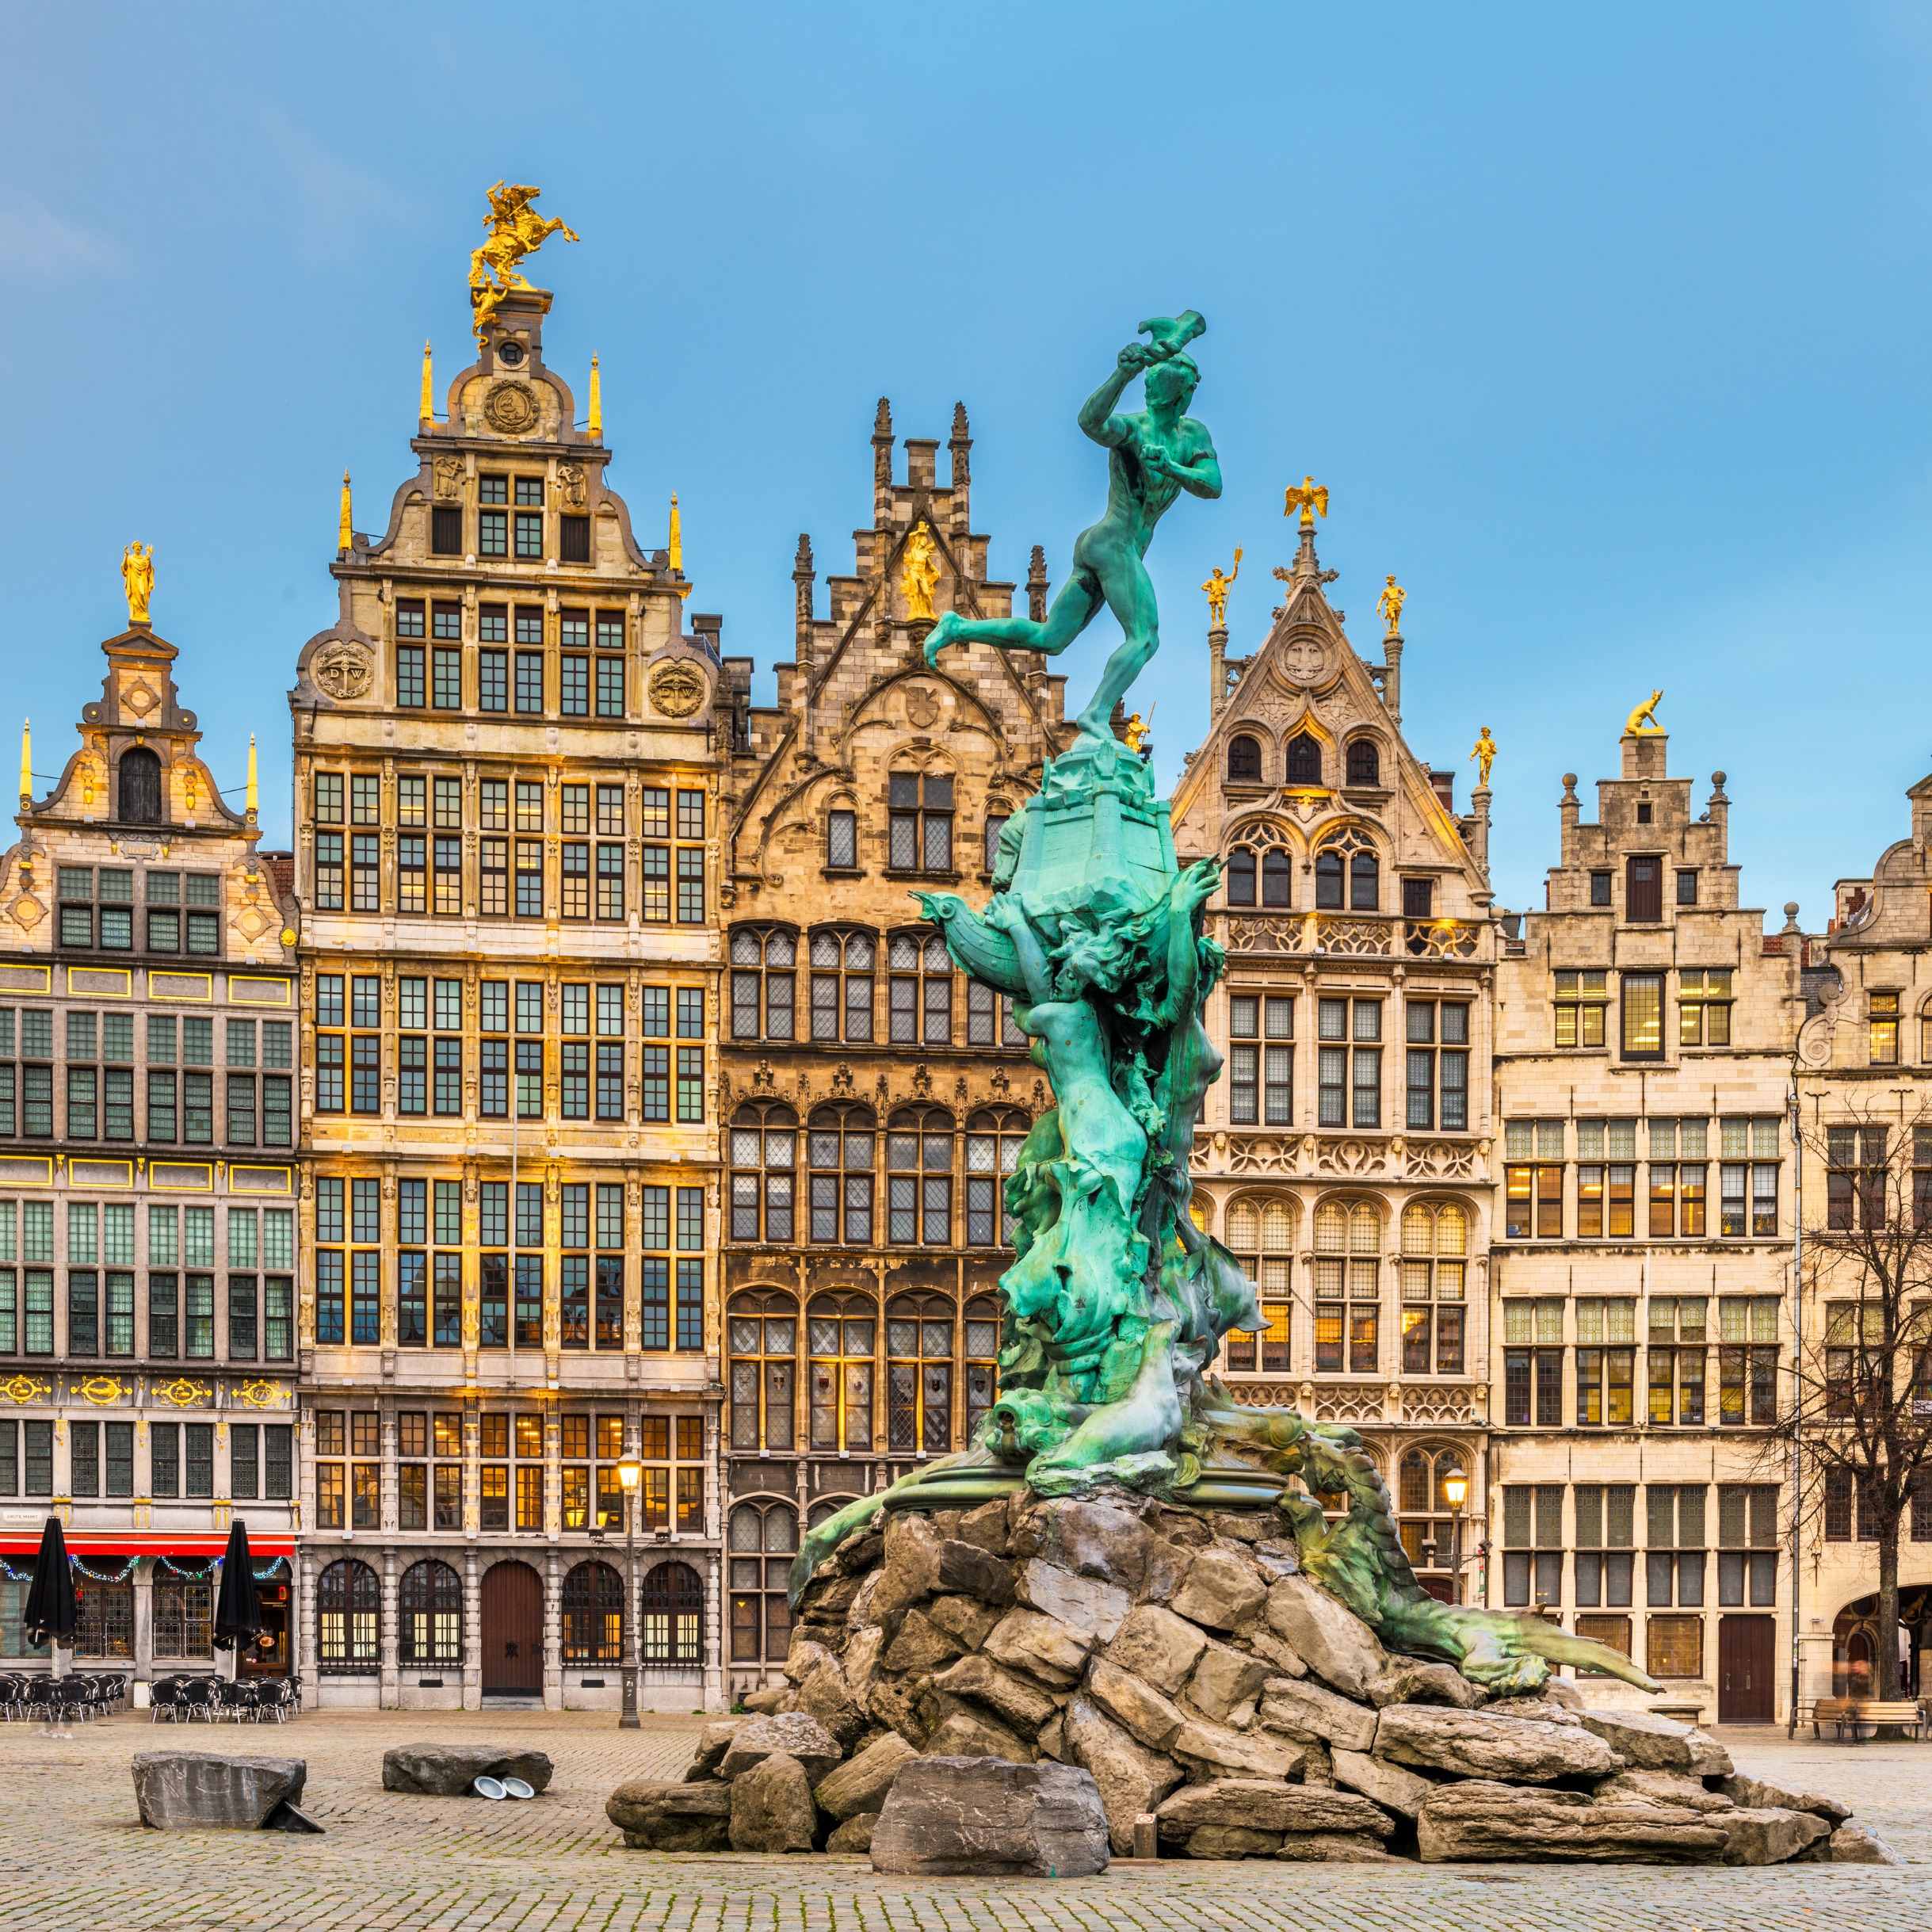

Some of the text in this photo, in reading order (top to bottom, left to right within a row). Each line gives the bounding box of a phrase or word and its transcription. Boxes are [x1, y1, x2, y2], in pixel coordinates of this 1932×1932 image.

[330, 669, 363, 679] D W
[662, 688, 693, 697] D W
[250, 1389, 271, 1400] 1579
